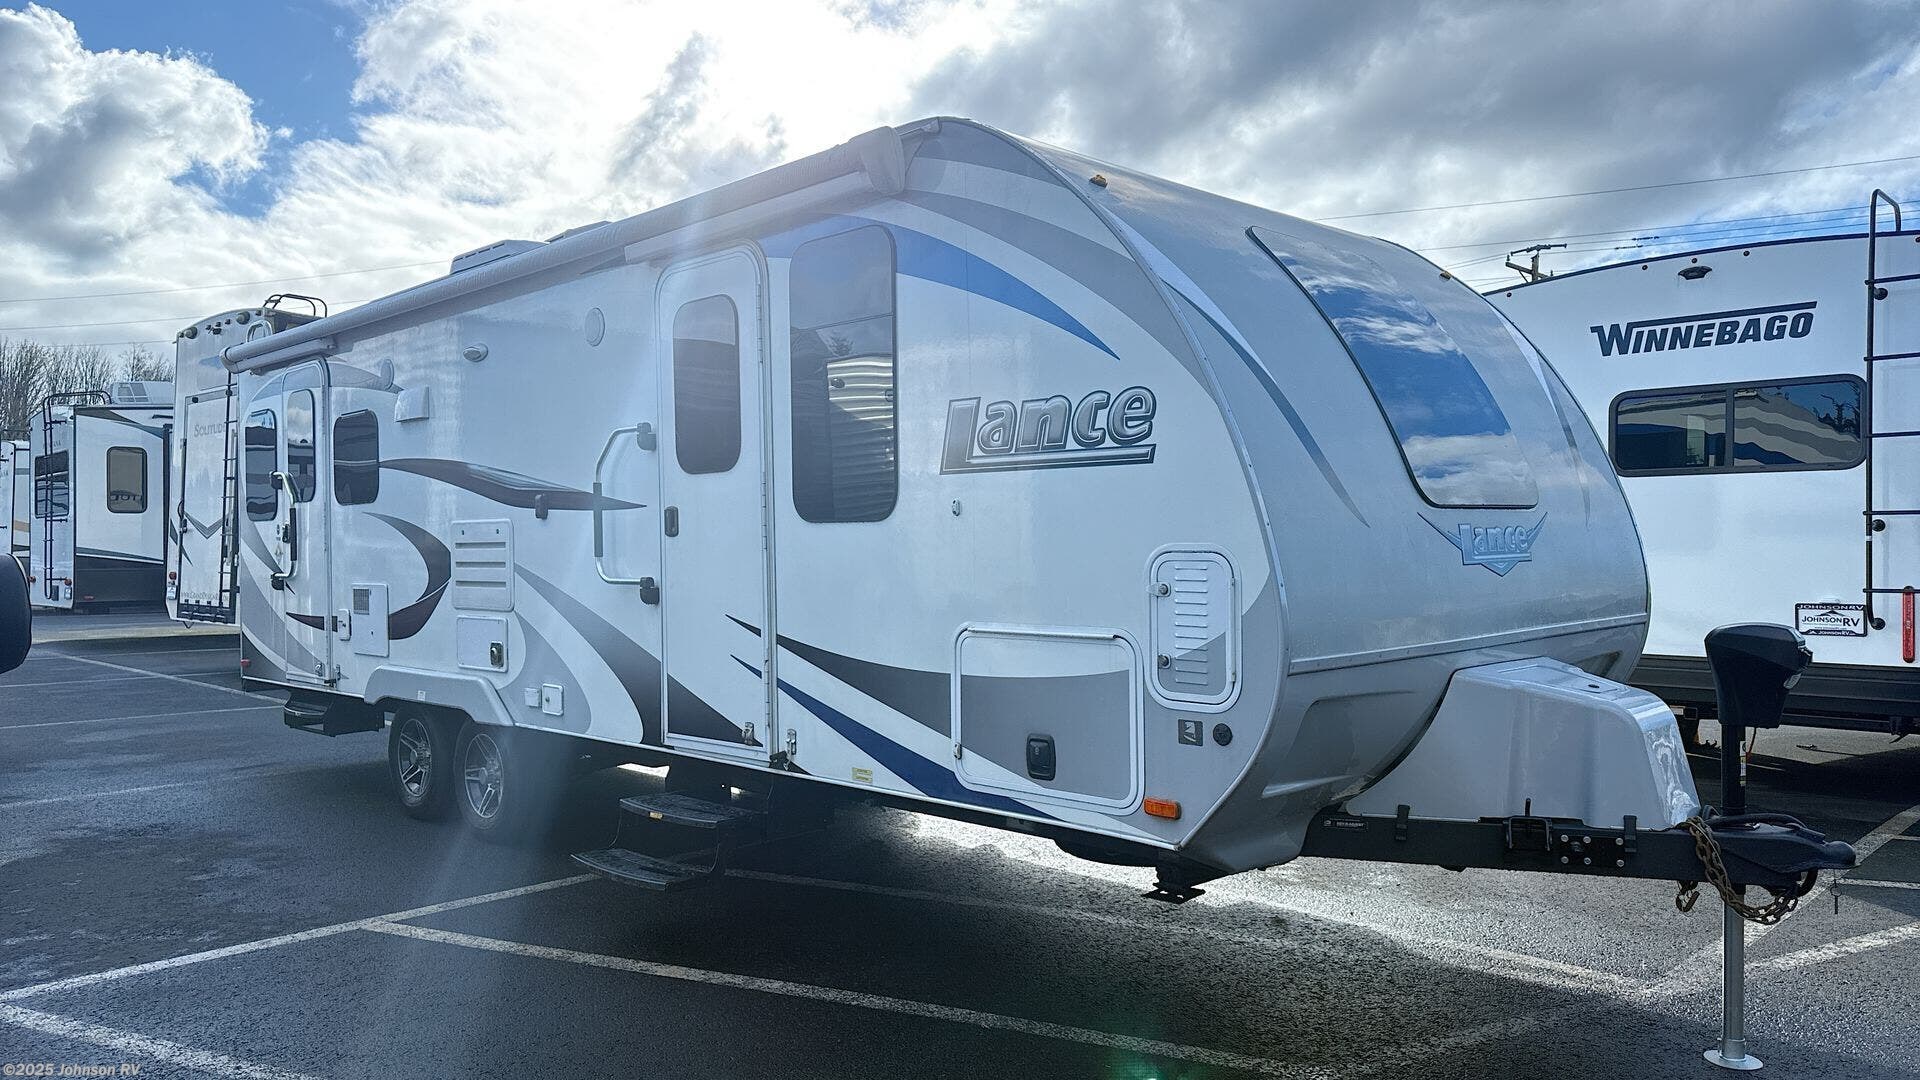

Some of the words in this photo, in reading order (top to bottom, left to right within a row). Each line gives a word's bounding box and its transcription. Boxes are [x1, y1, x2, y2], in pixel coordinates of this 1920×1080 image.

[1590, 301, 1817, 357] WINNEBAGO
[940, 385, 1157, 475] Lance
[1458, 523, 1532, 566] Lance
